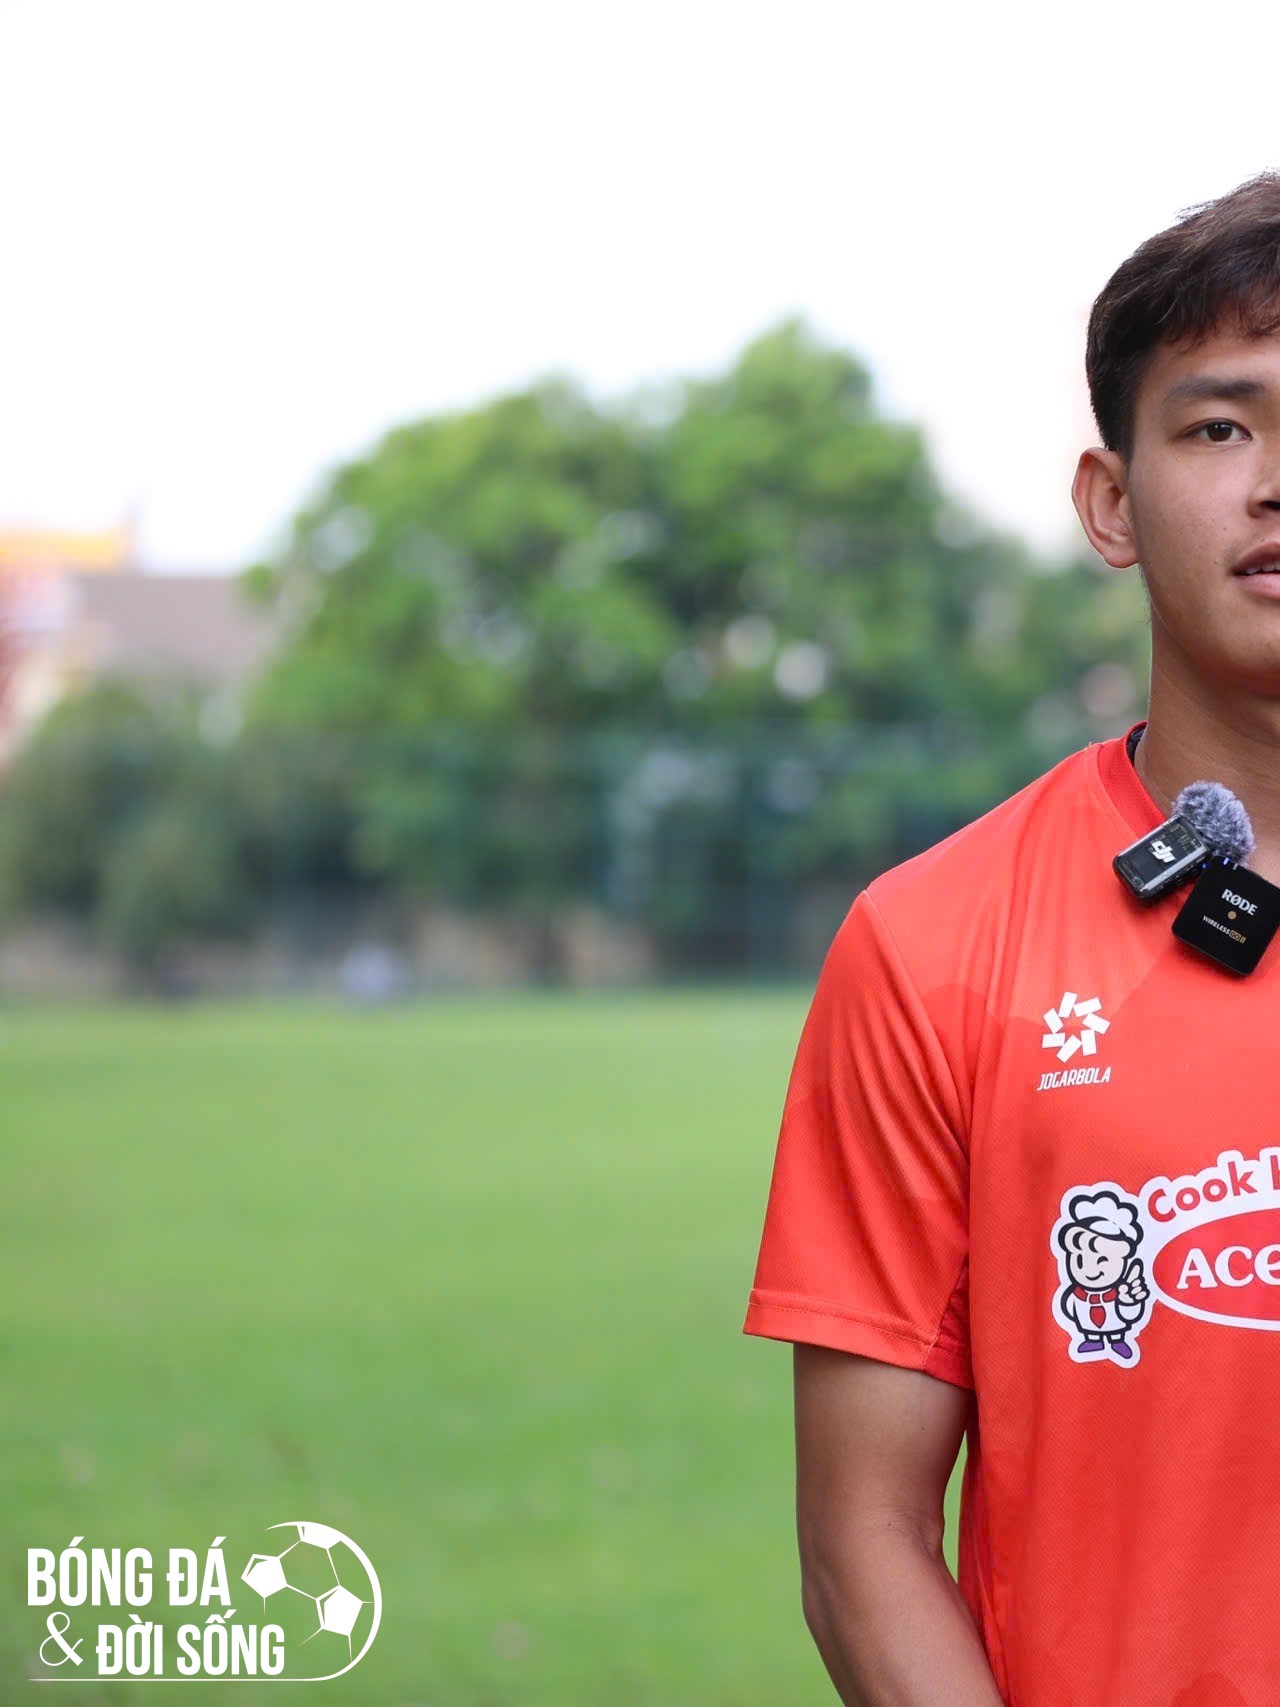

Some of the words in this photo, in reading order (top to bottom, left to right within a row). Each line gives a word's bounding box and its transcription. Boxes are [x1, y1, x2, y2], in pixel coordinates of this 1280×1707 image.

[1221, 888, 1258, 916] RØDE
[1202, 914, 1231, 935] WIRELESS
[1036, 1066, 1112, 1091] JOGARBOLA
[1147, 1161, 1258, 1223] Cook
